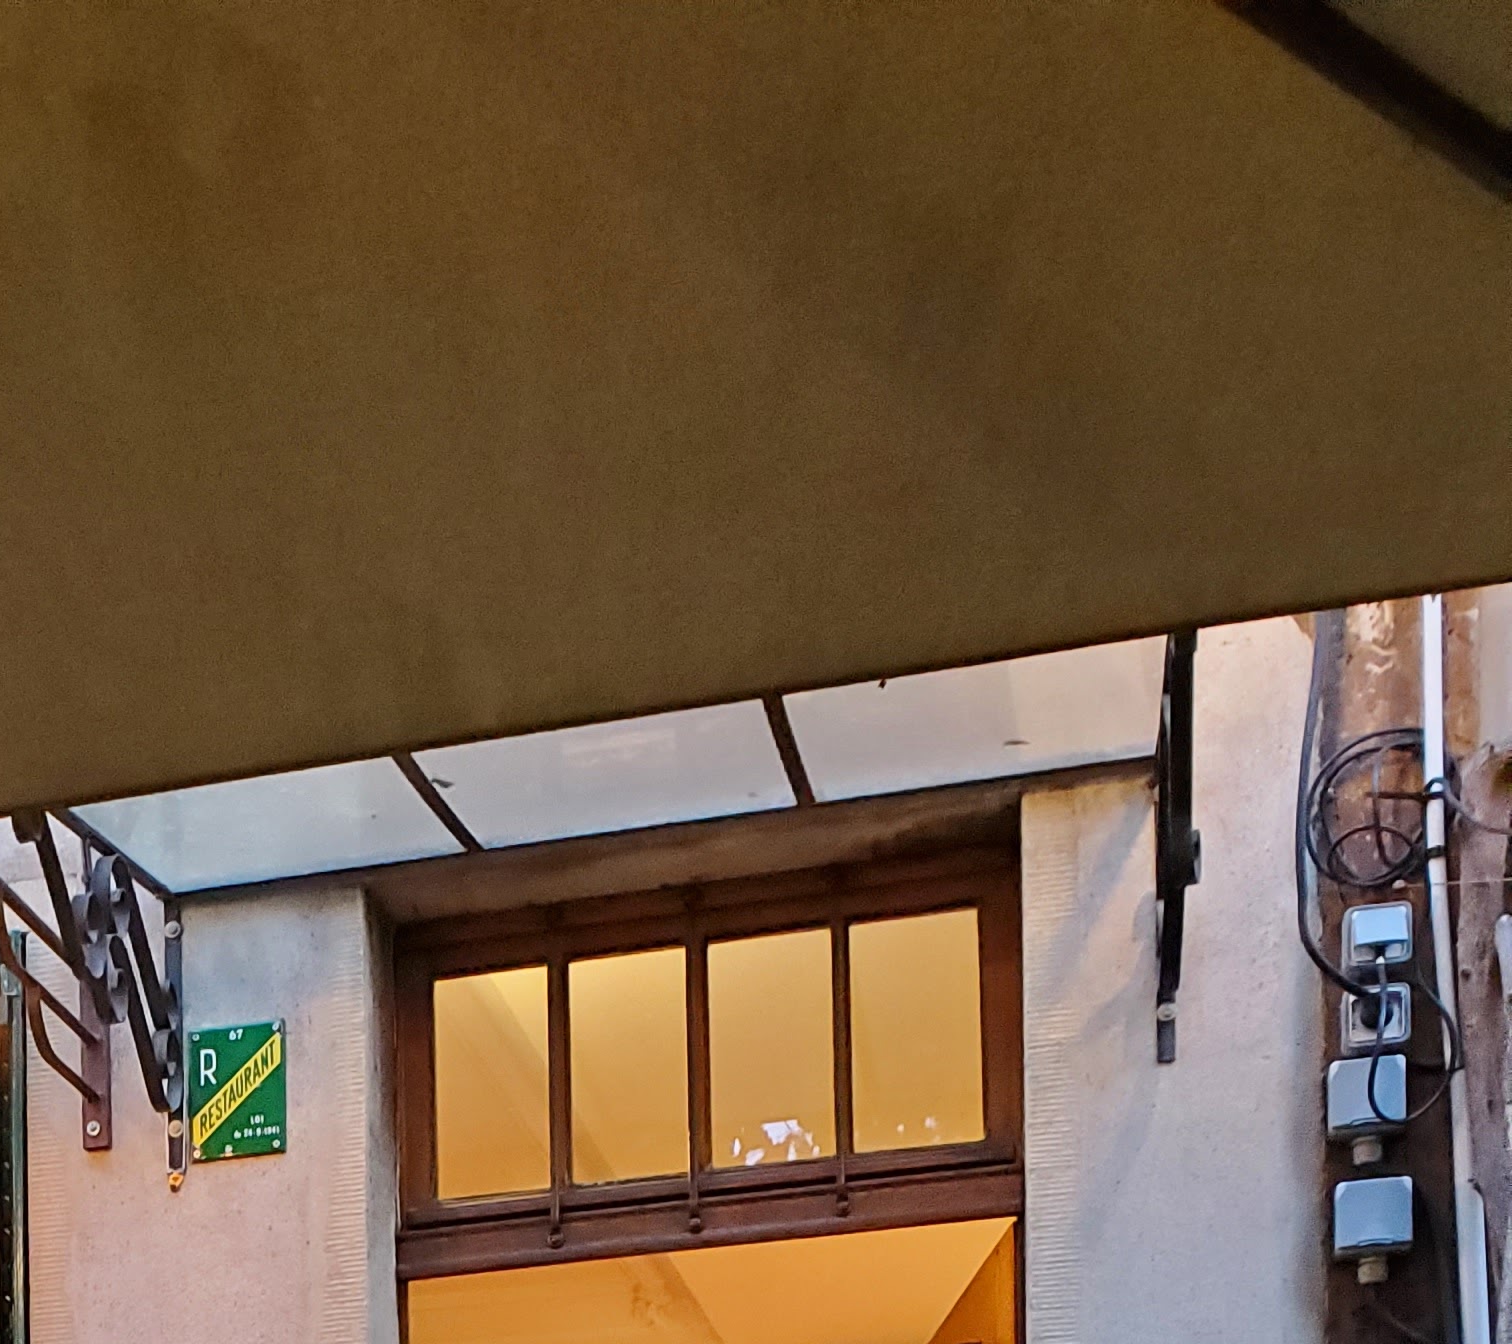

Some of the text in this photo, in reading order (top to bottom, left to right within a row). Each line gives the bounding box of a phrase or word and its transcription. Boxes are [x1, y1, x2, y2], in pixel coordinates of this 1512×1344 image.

[228, 1028, 244, 1041] 67
[199, 1048, 217, 1086] R
[199, 1039, 276, 1137] RESTAURANT
